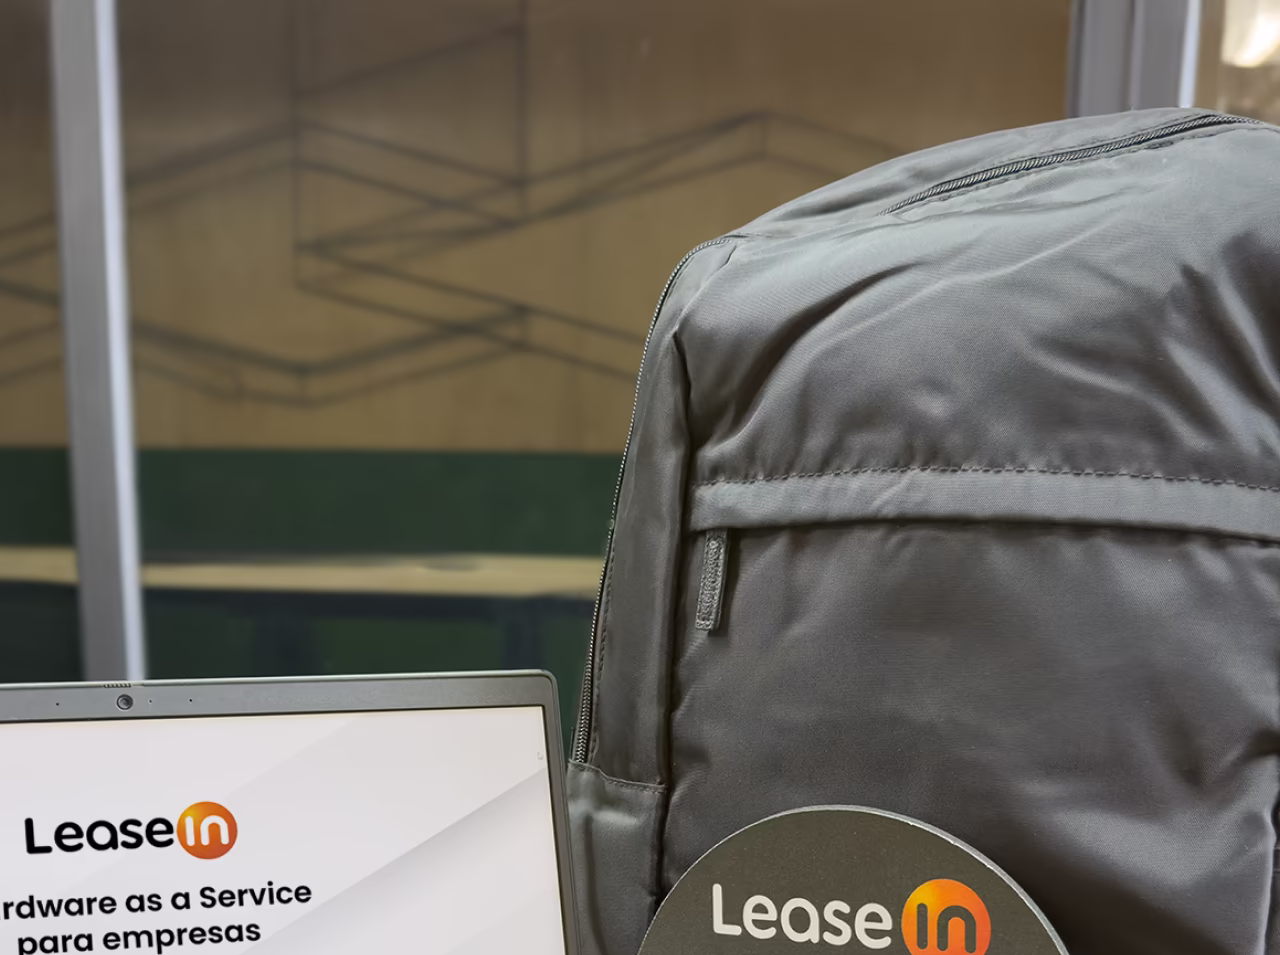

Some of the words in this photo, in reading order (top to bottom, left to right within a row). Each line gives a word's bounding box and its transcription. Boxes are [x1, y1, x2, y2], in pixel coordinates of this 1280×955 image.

[125, 893, 163, 913] as
[171, 891, 191, 909] a
[199, 881, 312, 909] Service
[102, 922, 262, 954] empresas
